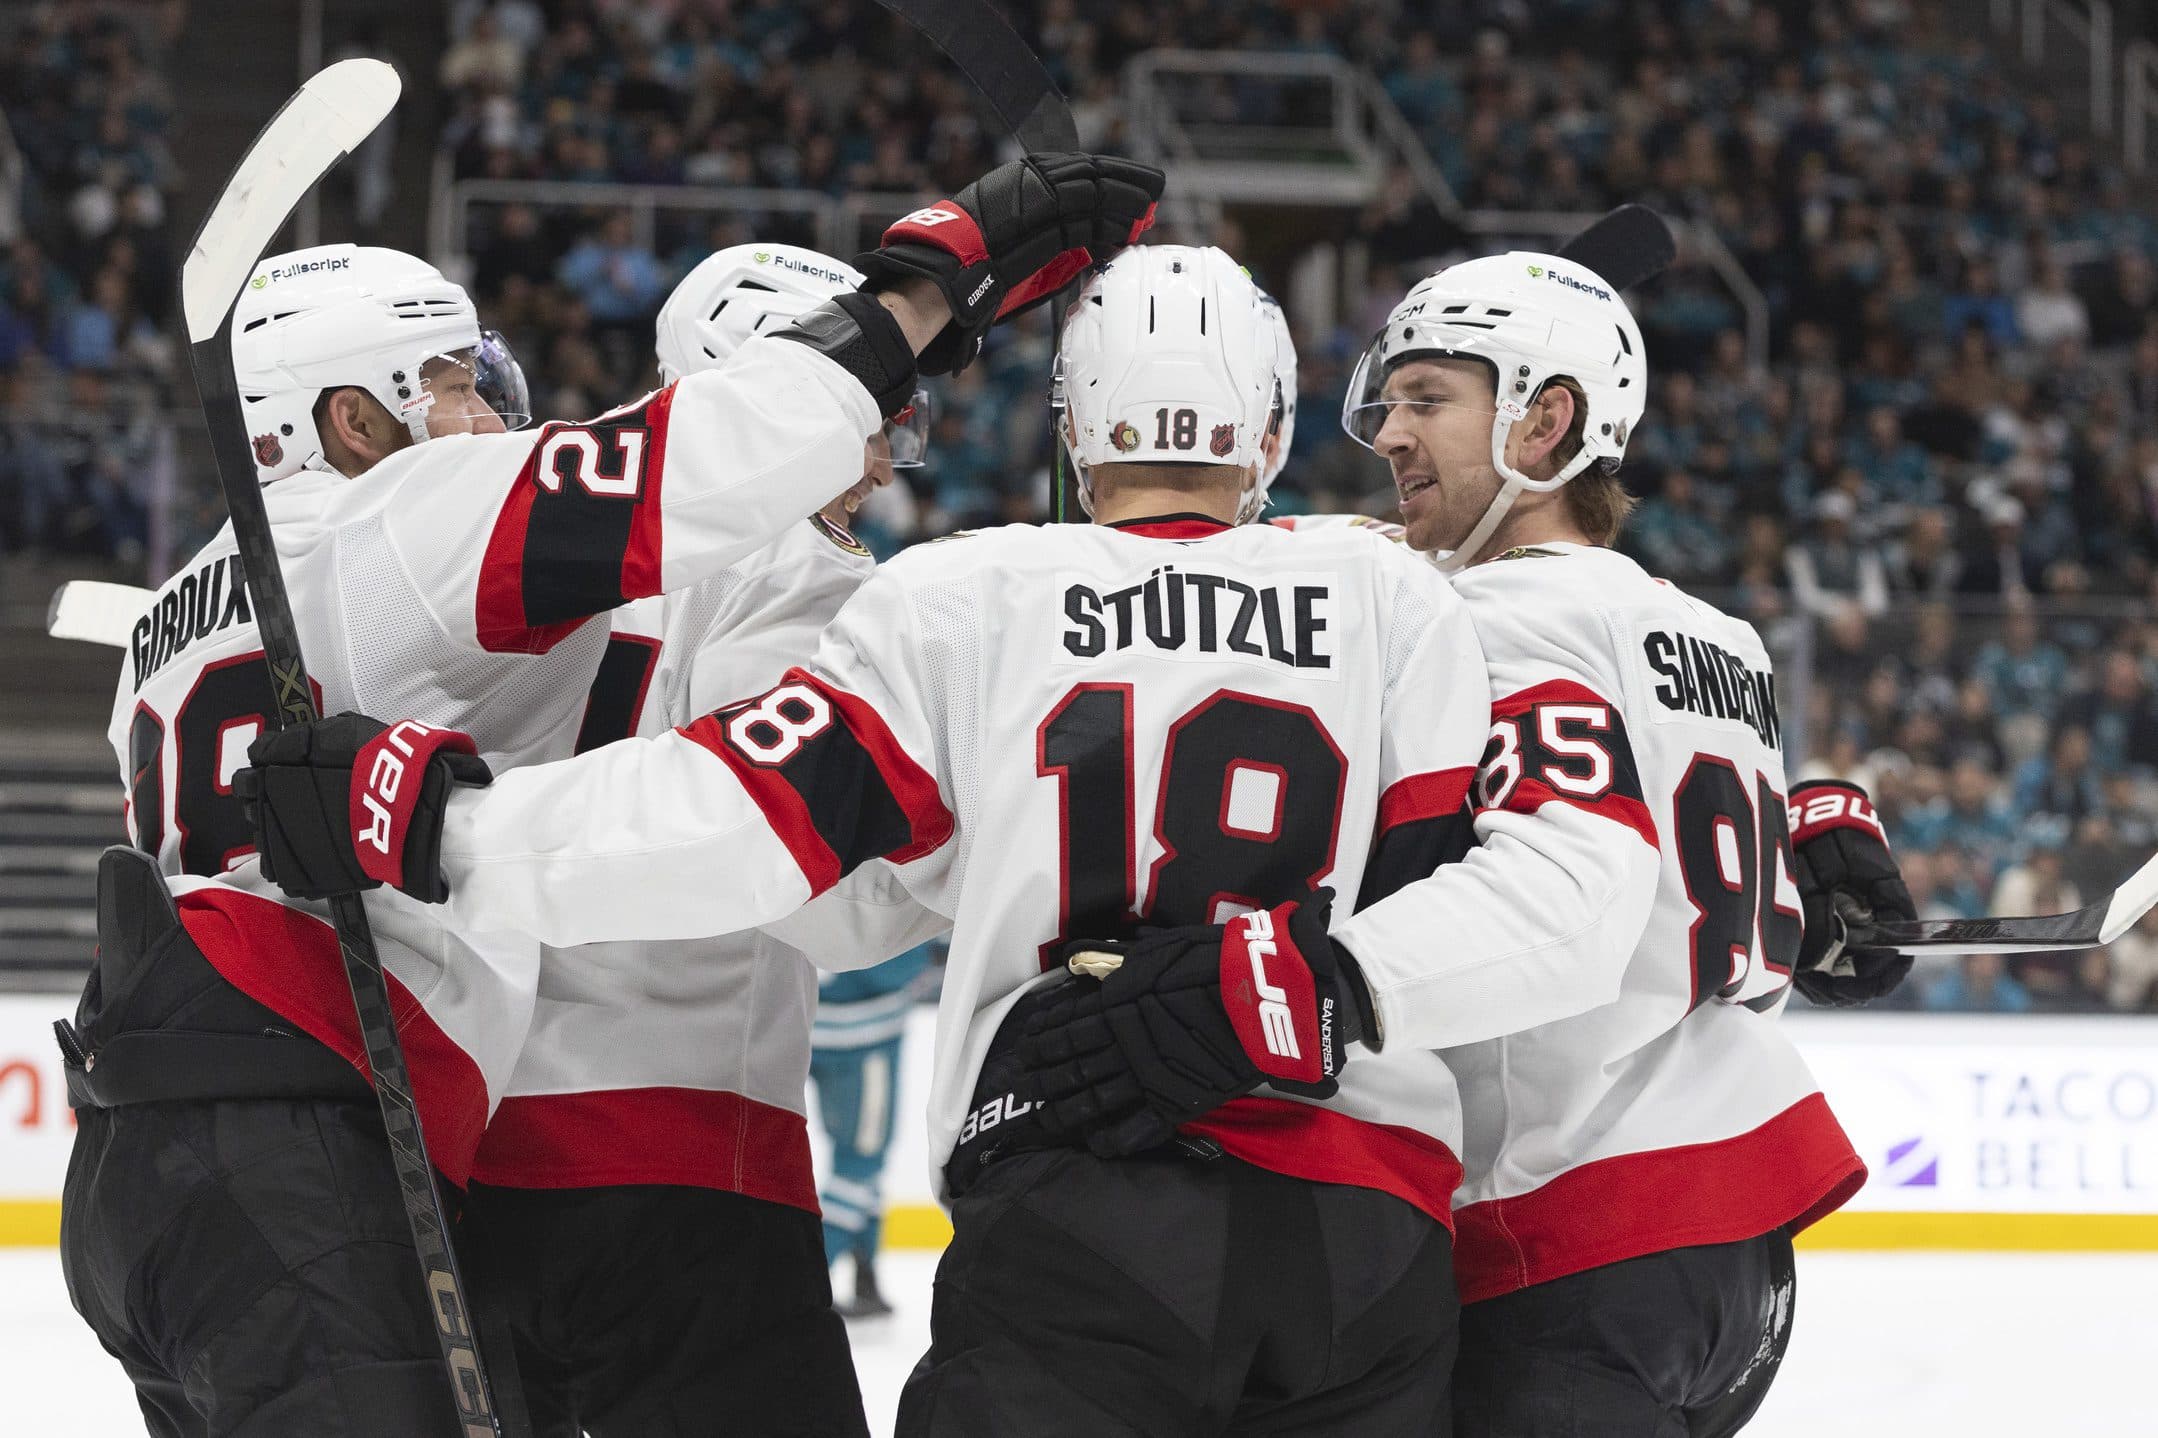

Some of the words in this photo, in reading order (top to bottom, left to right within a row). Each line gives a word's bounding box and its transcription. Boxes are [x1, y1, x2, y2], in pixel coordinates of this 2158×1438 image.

[272, 257, 350, 282] Fullscript
[774, 255, 845, 284] Fullscript
[967, 274, 995, 306] GIROUX
[1548, 270, 1612, 302] Fullscript
[1154, 407, 1198, 450] 18
[131, 553, 252, 695] GIROUX
[1063, 565, 1331, 669] STÜTZLE
[358, 718, 440, 855] UER
[1036, 681, 1349, 976] 18
[1239, 909, 1302, 1060] RUE
[1321, 997, 1334, 1077] SANDERSON
[1969, 1070, 2156, 1122] TACO
[1976, 1140, 2150, 1190] BELL
[428, 1269, 497, 1438] CC
